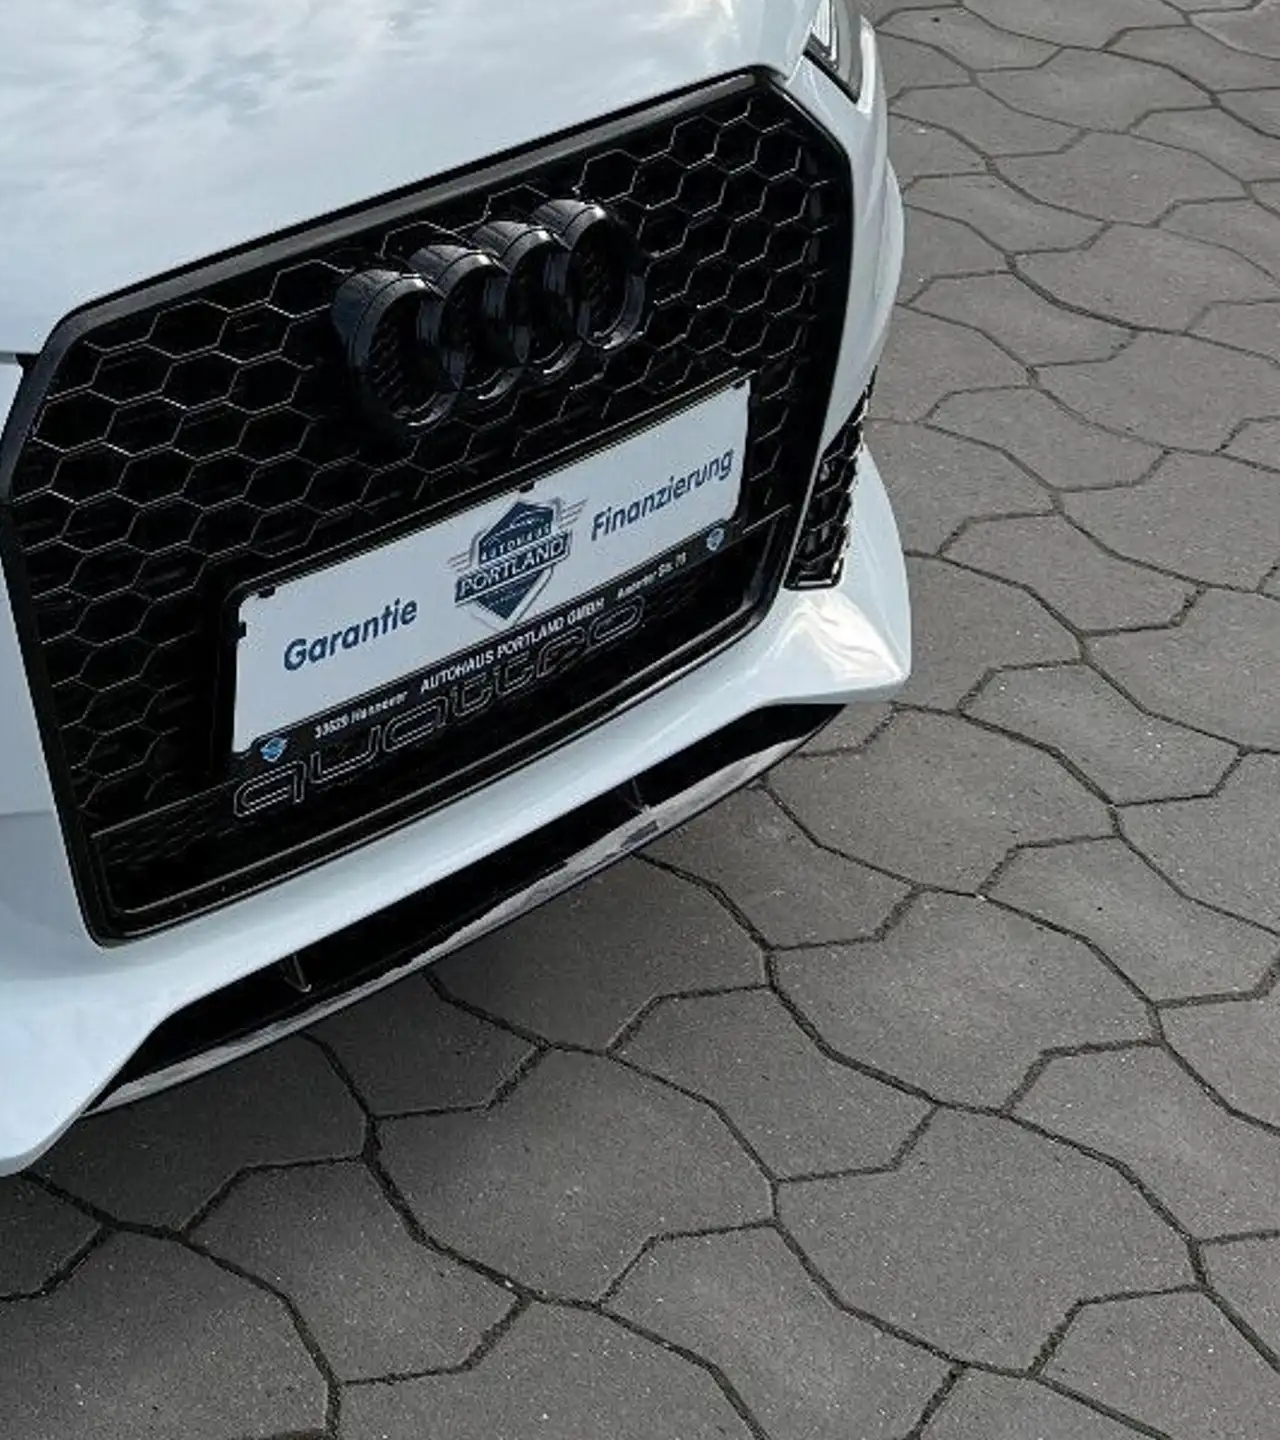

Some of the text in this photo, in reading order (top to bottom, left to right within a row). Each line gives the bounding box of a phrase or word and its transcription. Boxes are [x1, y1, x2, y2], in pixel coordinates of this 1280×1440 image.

[283, 448, 735, 671] Garantie Finanzierung
[459, 538, 565, 597] PORTLAND
[420, 650, 495, 693] AUTOHAUS
[496, 616, 565, 659] PORTLAND
[566, 597, 605, 626] GMBH
